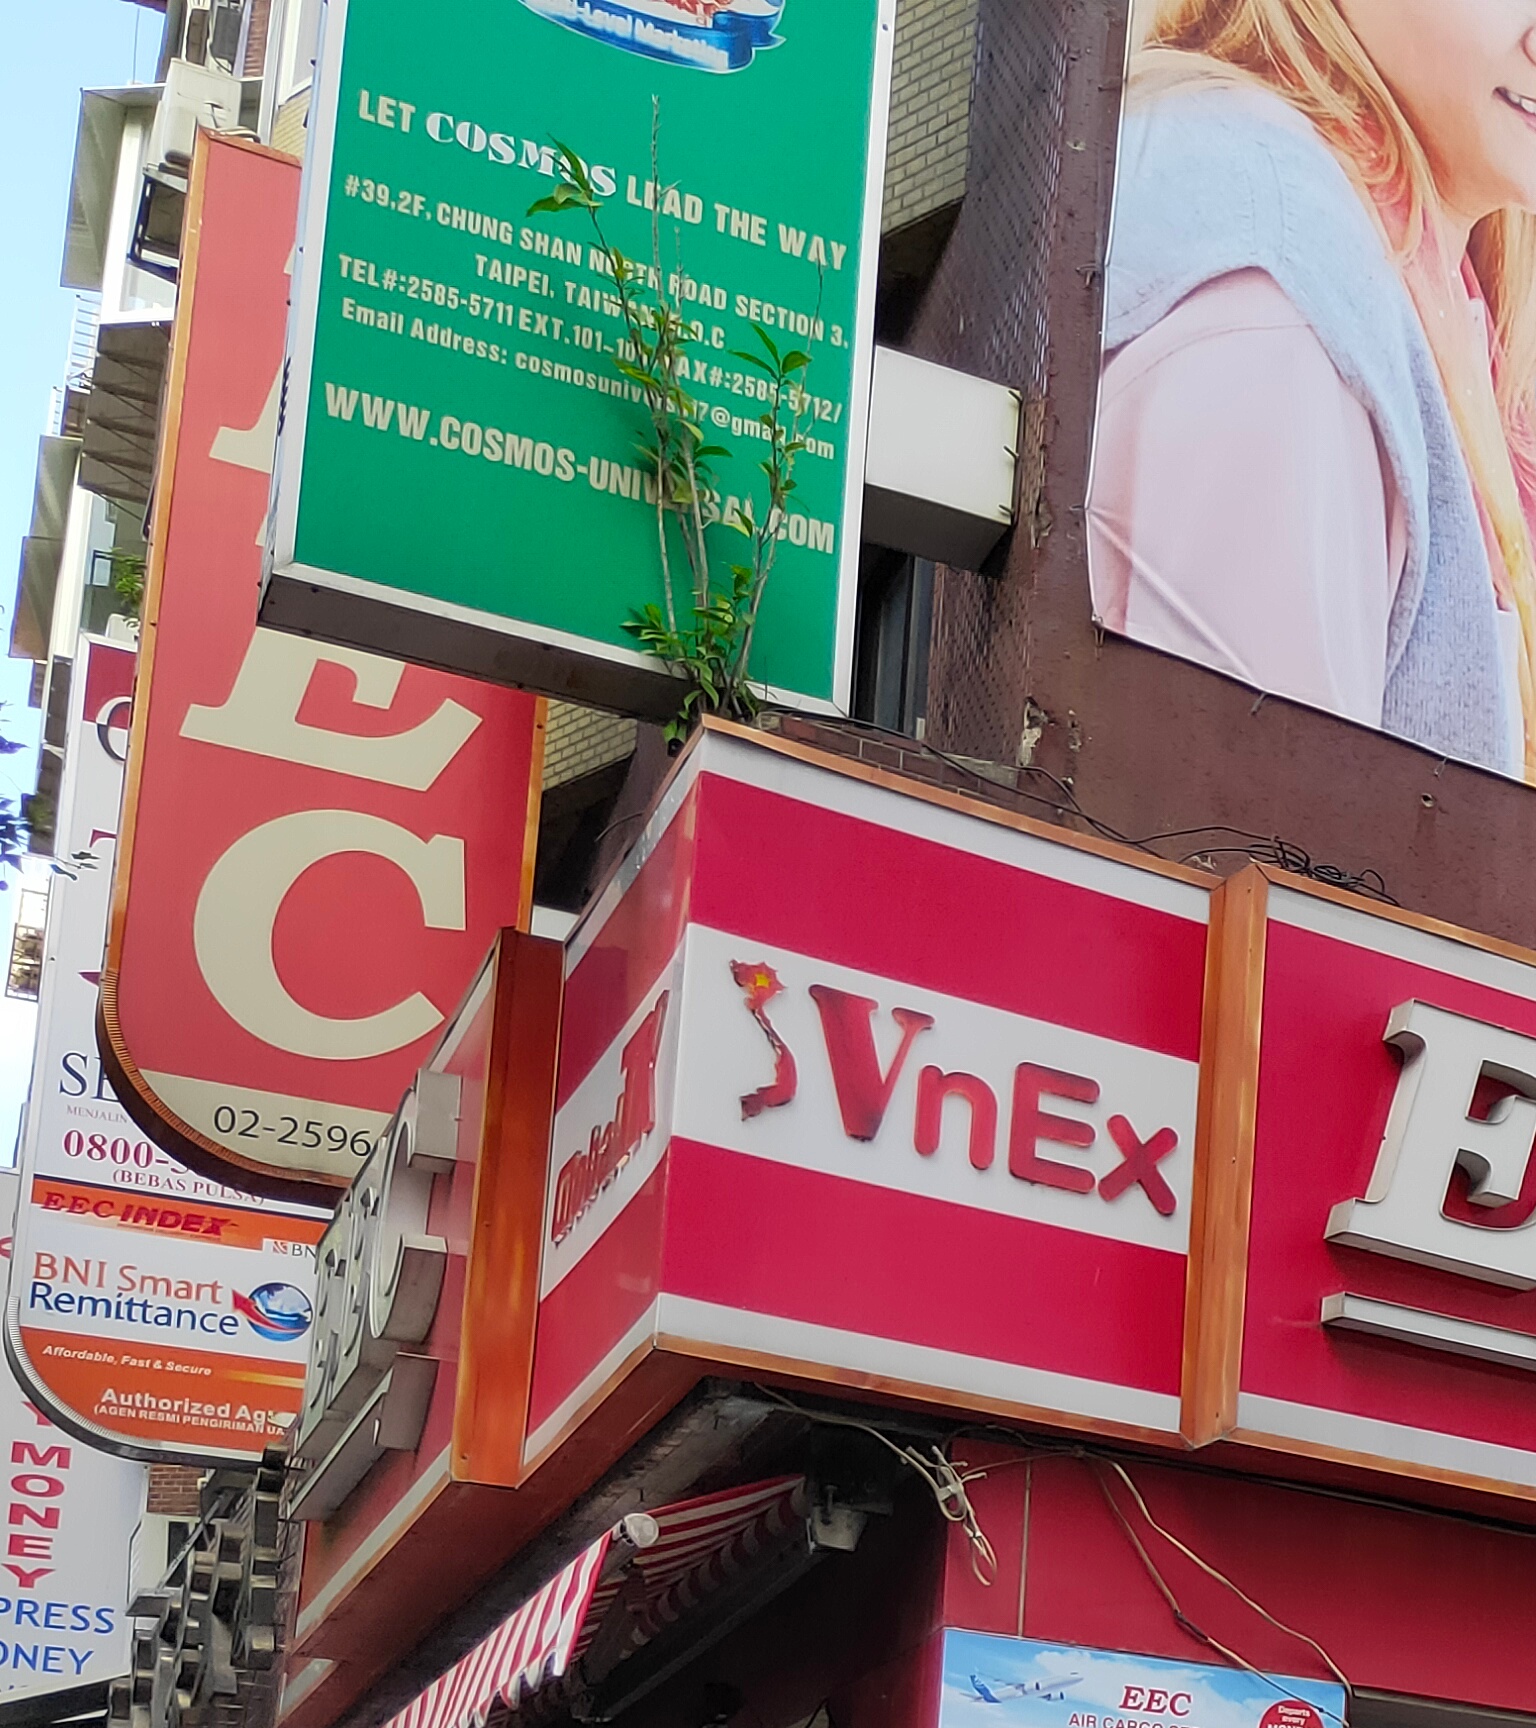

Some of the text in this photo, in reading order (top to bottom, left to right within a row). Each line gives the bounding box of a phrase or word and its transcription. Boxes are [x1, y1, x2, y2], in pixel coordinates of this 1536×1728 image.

[358, 88, 847, 270] LET COSMOS LEAD THE WAY
[436, 202, 513, 245] CHUNG
[519, 227, 583, 266] SHAN
[668, 272, 728, 311] ROAD
[735, 294, 826, 342] SECTION
[341, 296, 508, 364] Email Address:
[808, 982, 1179, 1217] VnEx
[41, 1190, 238, 1238] EEC INDEX
[32, 1252, 224, 1305] BNI Smart
[29, 1280, 241, 1337] Remittance
[42, 1344, 213, 1376] Affordable, Fast Secure
[100, 1387, 232, 1419] Authorized
[2, 1441, 72, 1589] MONEY
[1118, 1684, 1192, 1717] EEC
